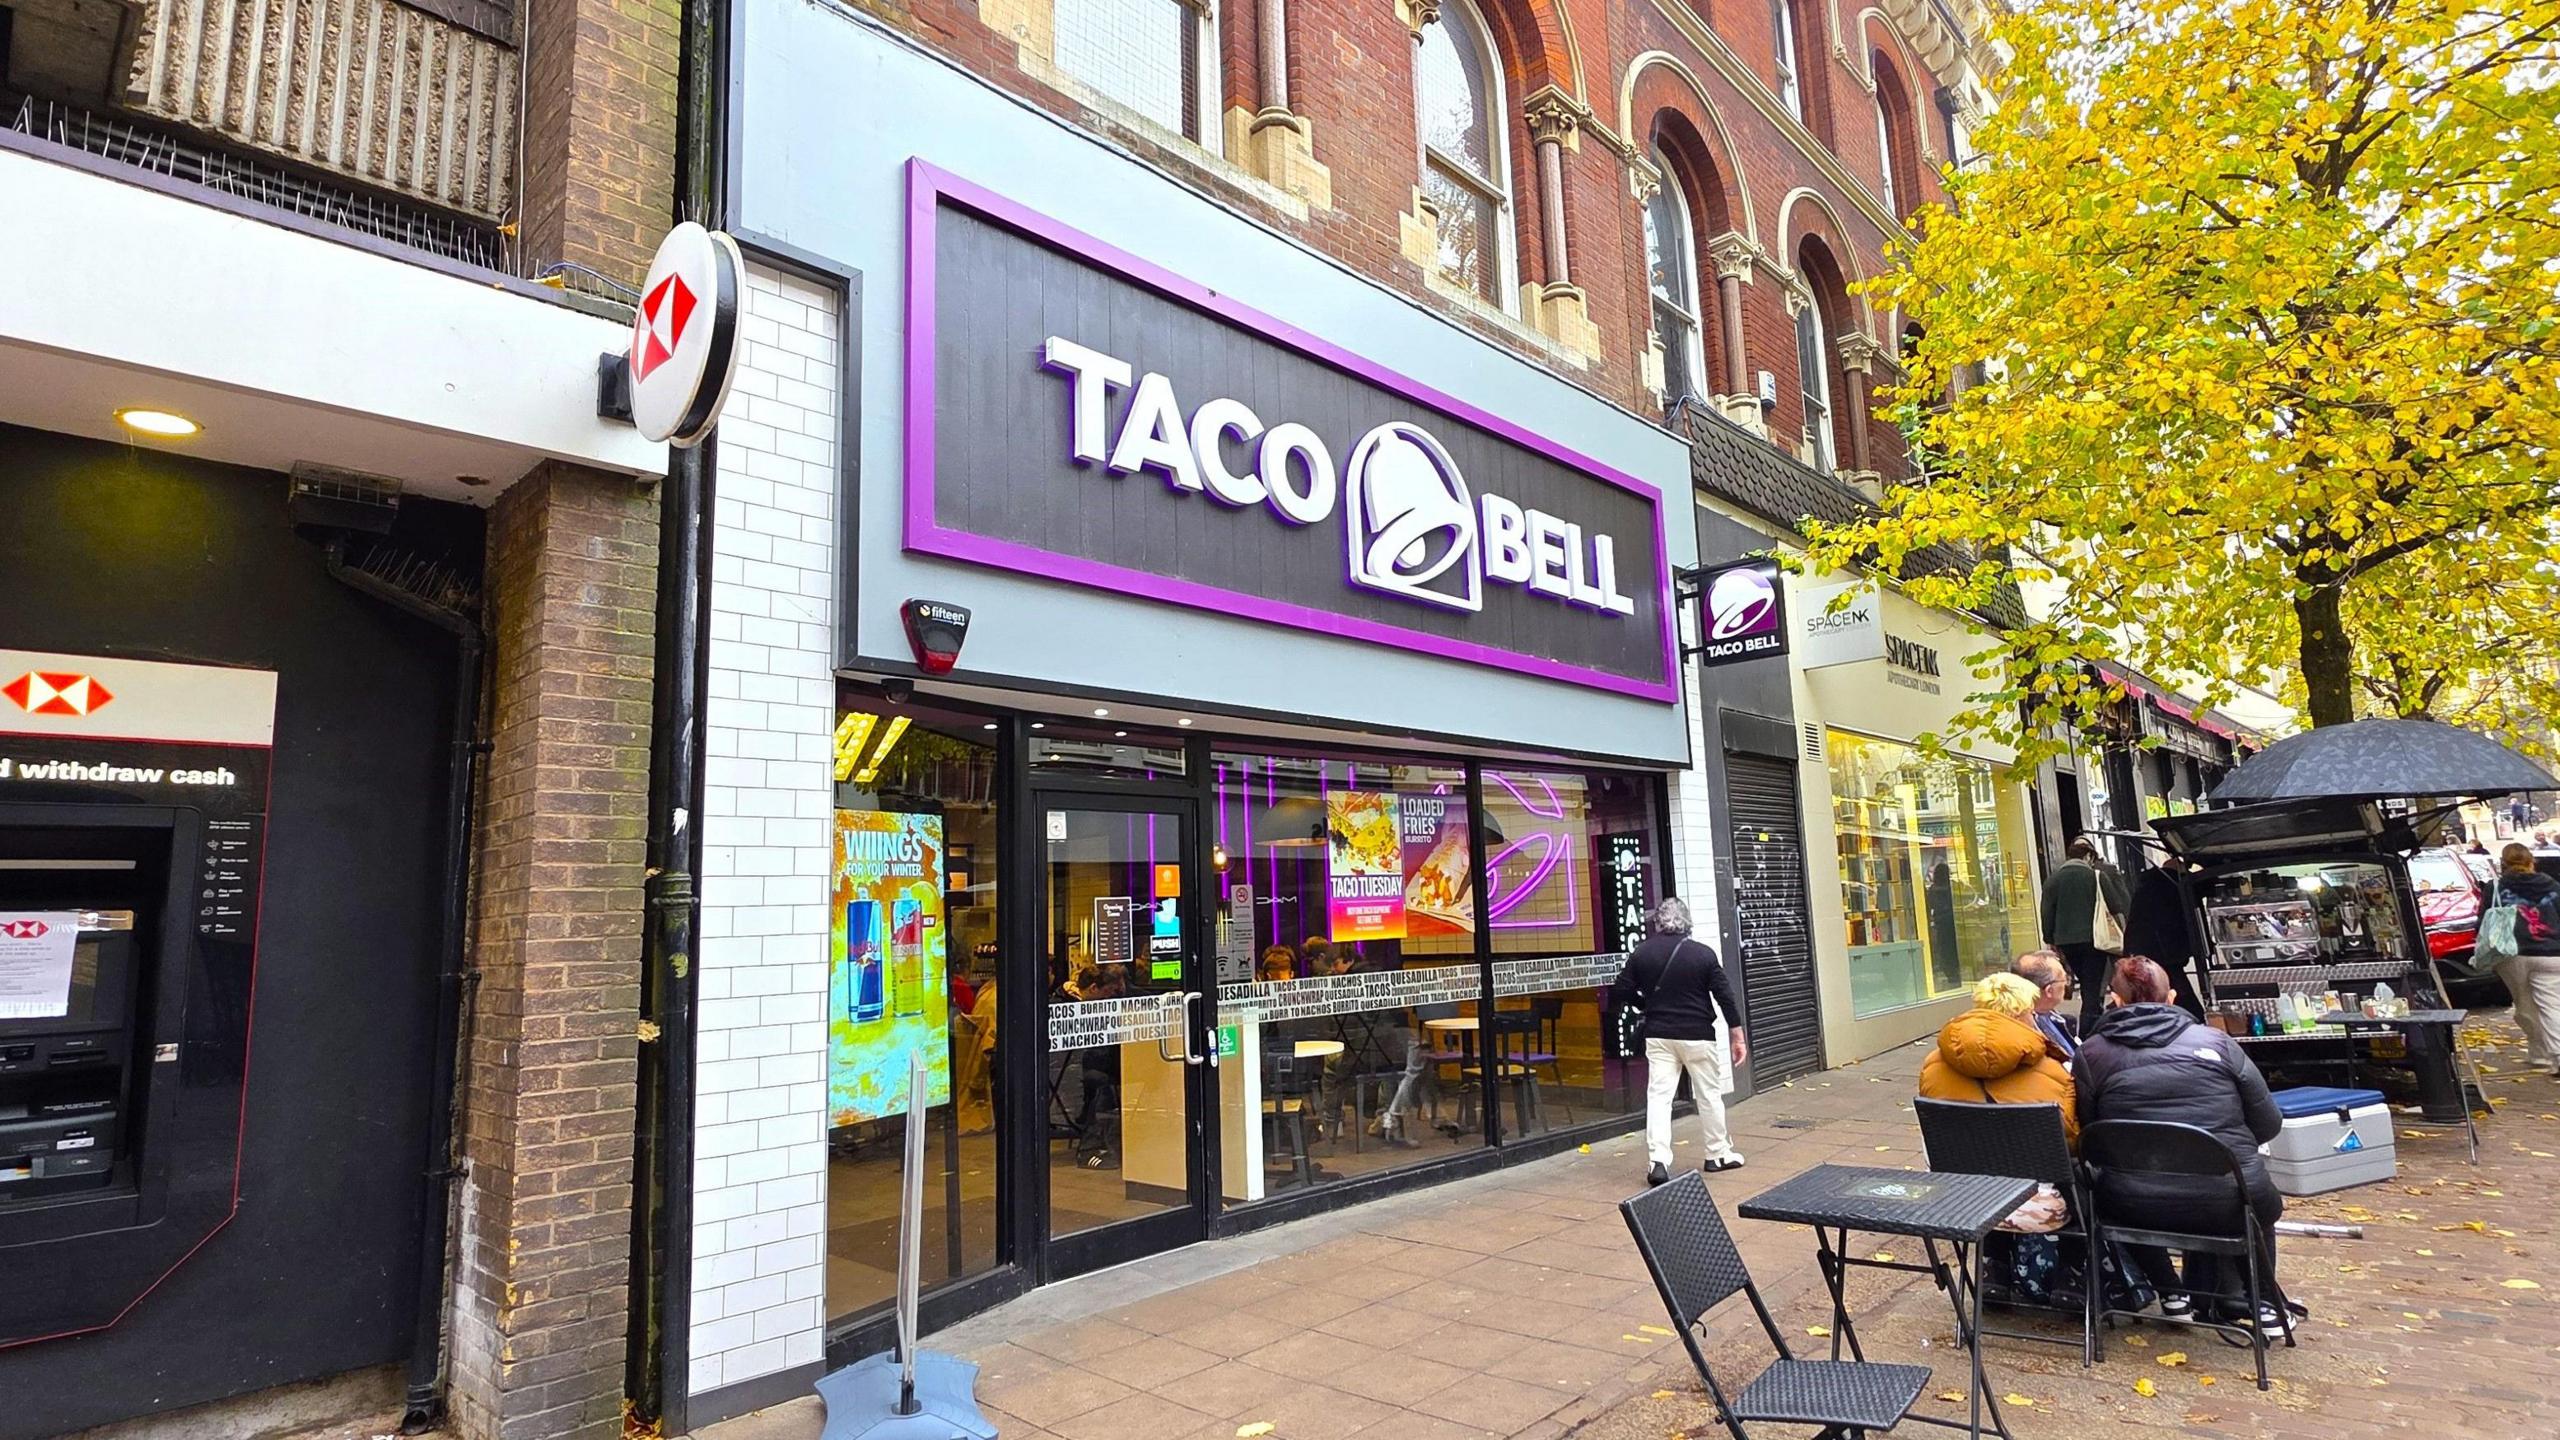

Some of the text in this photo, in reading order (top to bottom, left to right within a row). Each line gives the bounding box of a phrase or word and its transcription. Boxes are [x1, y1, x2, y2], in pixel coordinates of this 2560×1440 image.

[1046, 335, 1635, 616] TACO BELL
[931, 606, 965, 622] fifteen
[1707, 635, 1780, 658] TACO BELL
[19, 760, 163, 783] withdraw
[169, 767, 235, 785] cash
[1403, 798, 1444, 817] LOADED
[1404, 816, 1435, 835] FRIES
[1405, 835, 1432, 844] BURRITO
[846, 863, 863, 876] FOR
[867, 863, 889, 876] YOUR
[1331, 876, 1403, 898] TACO TUESDAY
[1622, 876, 1640, 953] TAC
[1152, 938, 1179, 949] PUSH
[1515, 961, 1554, 974] QUESADILLA
[1274, 980, 1297, 992] TACOS
[1299, 979, 1328, 990] BURRITO
[1331, 975, 1362, 988] NACHOS
[1364, 973, 1389, 983] BURRITO
[1390, 970, 1438, 986] QUESADILLA
[1438, 968, 1457, 978] TACOS
[1495, 972, 1516, 985] TACOS
[1278, 990, 1324, 1007] CRUNCHWRAP
[1325, 987, 1365, 1001] QUESADILLA
[1365, 983, 1390, 998] TACOS
[1301, 1004, 1331, 1016] NACHOS
[1333, 1000, 1358, 1012] BURRITO
[1360, 998, 1401, 1009] QUESADILLA
[1431, 993, 1449, 1003] TACOS
[1450, 990, 1477, 1000] NACHOS
[1081, 1001, 1117, 1015] BURRITO
[1121, 997, 1160, 1013] NACHOS
[1050, 1016, 1109, 1037] CRUNCHWRAP
[1110, 1012, 1161, 1029] QUESADILLA
[1062, 1033, 1104, 1048] NACHOS
